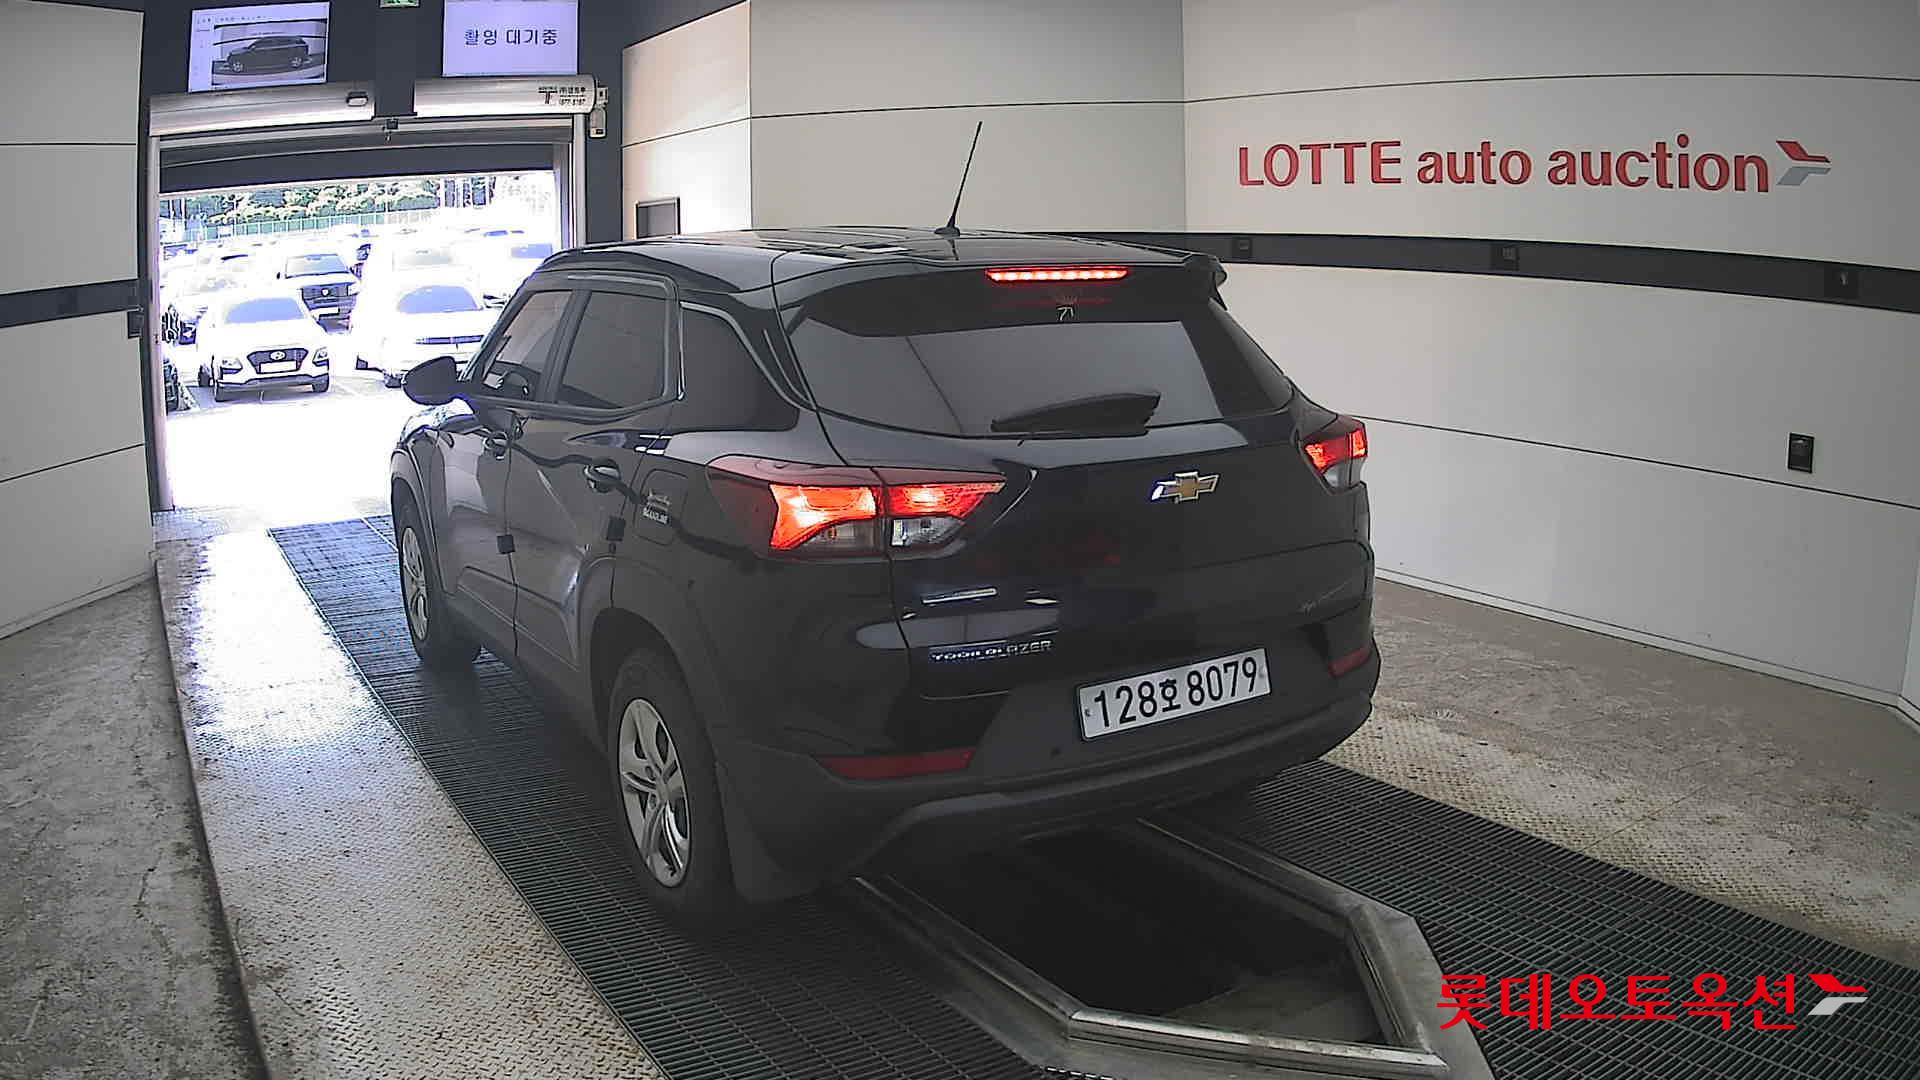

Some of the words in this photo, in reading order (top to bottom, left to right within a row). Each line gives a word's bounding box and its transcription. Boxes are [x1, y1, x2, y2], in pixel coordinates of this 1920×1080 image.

[505, 29, 558, 46] 대기중
[1238, 140, 1401, 187] LOTTE
[1416, 141, 1532, 185] auto
[1547, 133, 1769, 192] auction
[1186, 656, 1257, 707] 8079
